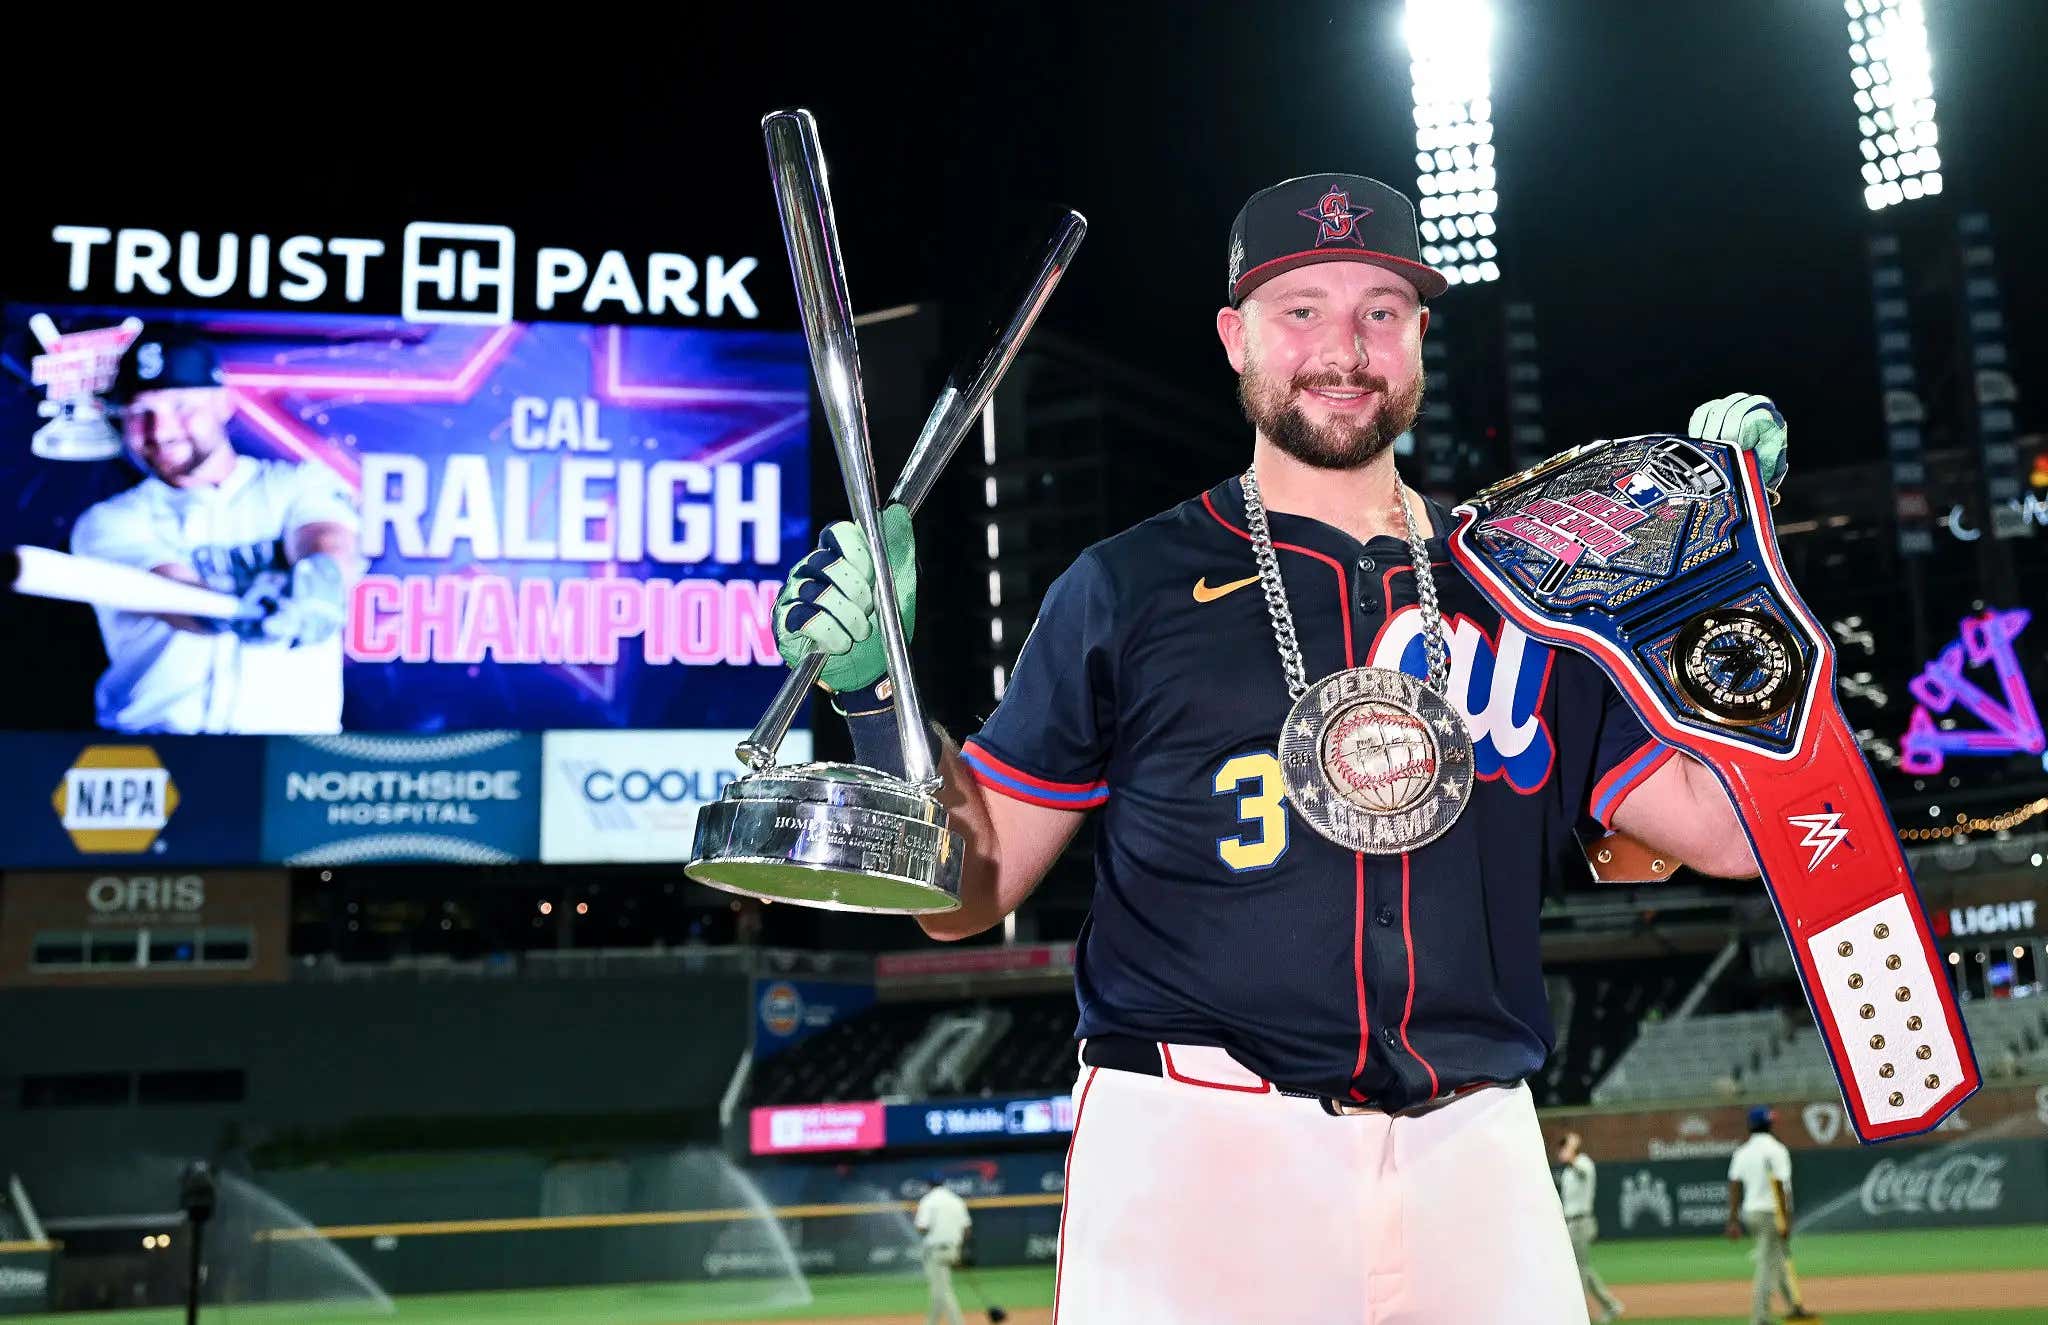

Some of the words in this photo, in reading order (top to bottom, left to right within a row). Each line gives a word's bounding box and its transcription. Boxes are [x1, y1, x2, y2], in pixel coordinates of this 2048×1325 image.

[52, 225, 386, 302] TRUIST
[536, 247, 760, 319] PARK
[510, 396, 613, 451] CAL
[360, 453, 781, 565] RALEIGH
[345, 576, 785, 666] CHAMPION
[1320, 670, 1422, 717] DERBY
[74, 777, 158, 818] NAPA
[286, 770, 521, 802] NORTHSIDE
[327, 803, 478, 826] HOSPITAL
[1327, 796, 1440, 850] CHAMP
[87, 875, 205, 912] ORIS
[1949, 900, 2037, 937] LIGHT
